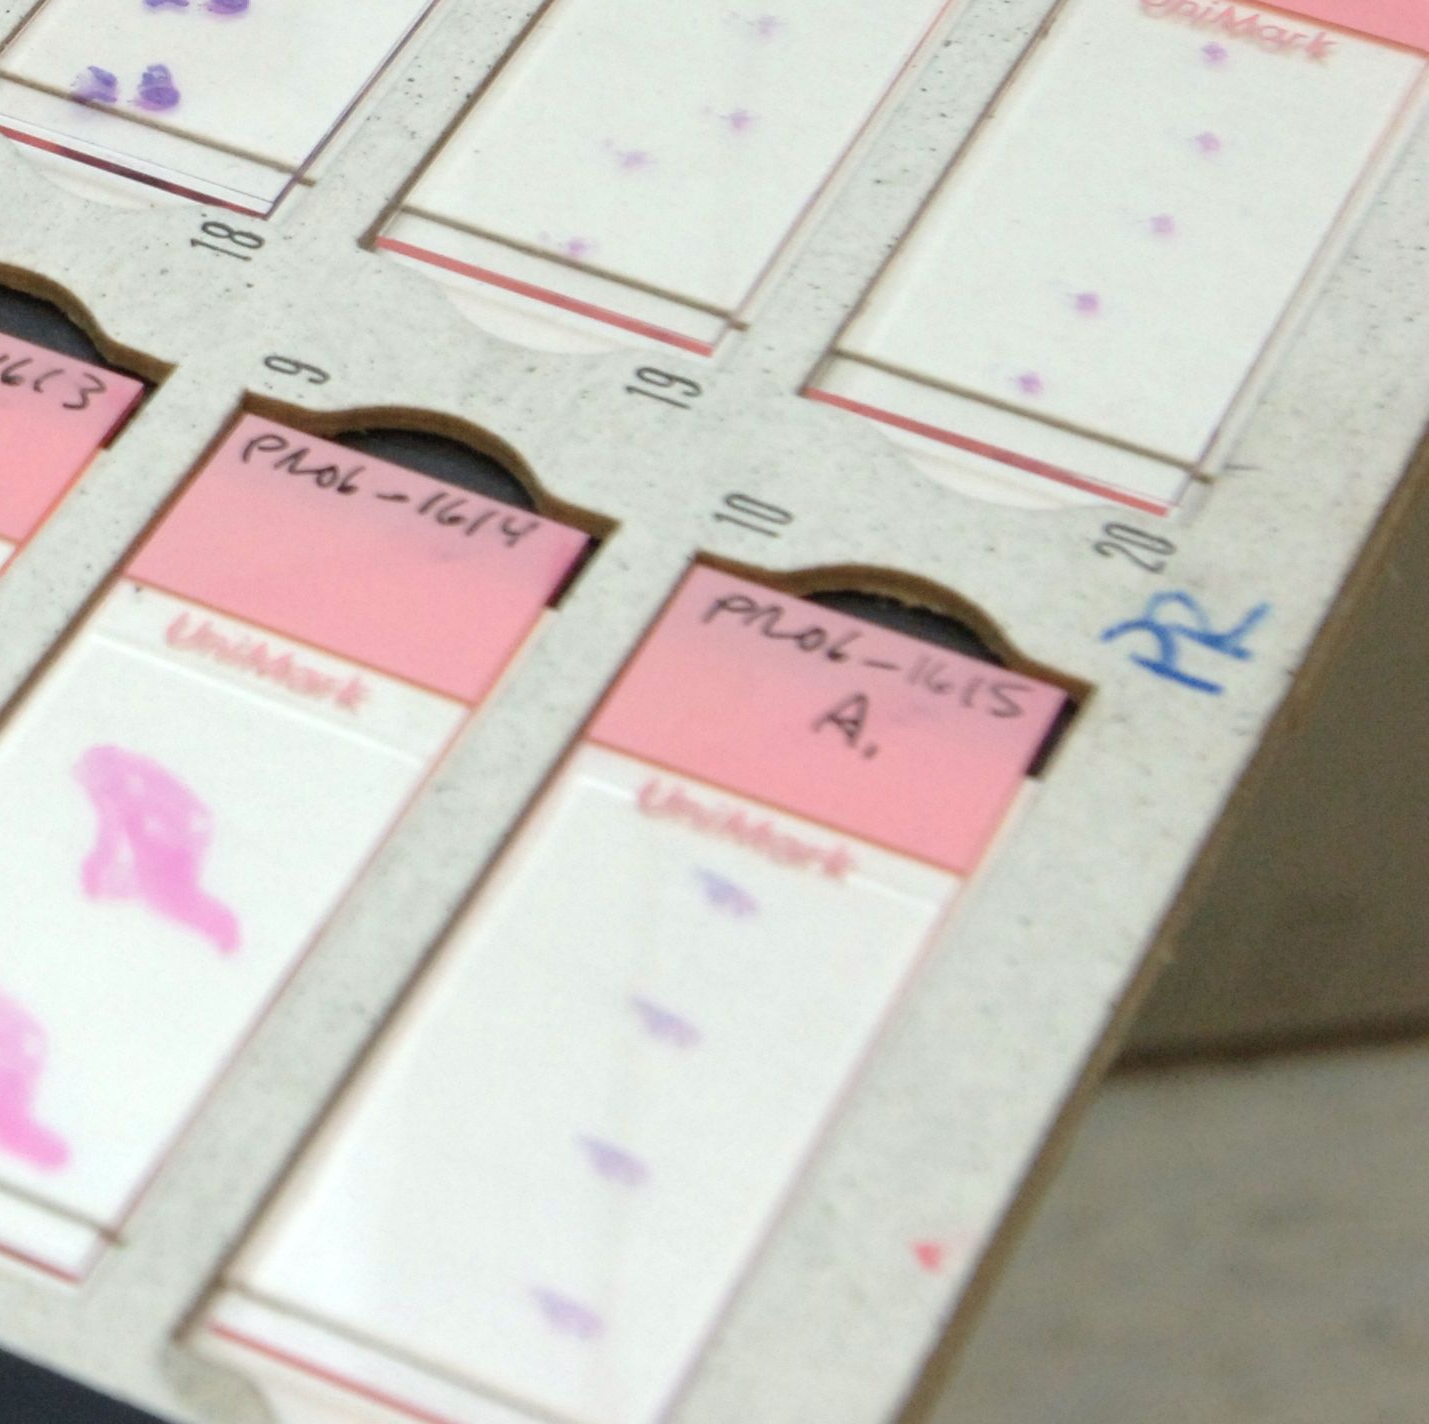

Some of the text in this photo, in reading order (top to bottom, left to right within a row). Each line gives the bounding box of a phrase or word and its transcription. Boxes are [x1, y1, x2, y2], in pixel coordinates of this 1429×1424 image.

[190, 220, 266, 261] 18
[263, 354, 331, 386] 9
[624, 365, 702, 409] 19
[712, 493, 794, 538] 10
[1094, 521, 1177, 574] 20
[165, 612, 371, 716] UniMark
